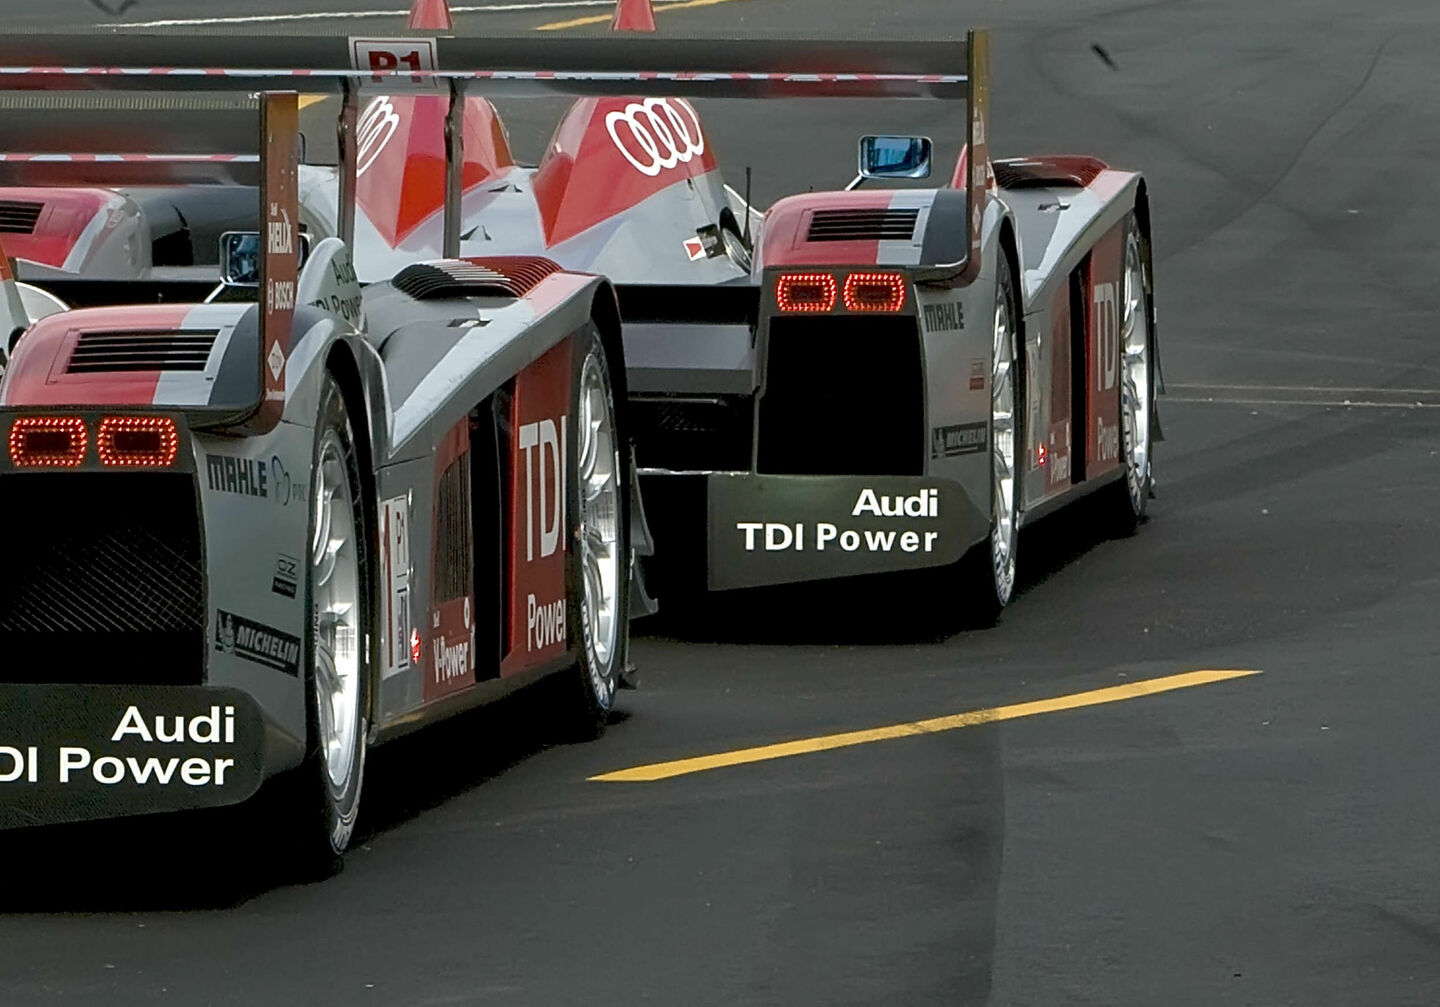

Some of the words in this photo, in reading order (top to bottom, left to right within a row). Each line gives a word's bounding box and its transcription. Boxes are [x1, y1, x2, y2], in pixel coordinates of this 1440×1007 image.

[368, 51, 422, 82] P1
[275, 282, 293, 309] BOSCH
[206, 454, 267, 497] MAHLE
[519, 415, 567, 562] TDI
[852, 489, 938, 517] Audi
[737, 523, 803, 550] TDI
[817, 523, 938, 552] Power
[237, 625, 298, 663] MICHELIN
[111, 706, 234, 742] Audi
[60, 747, 234, 785] Power
